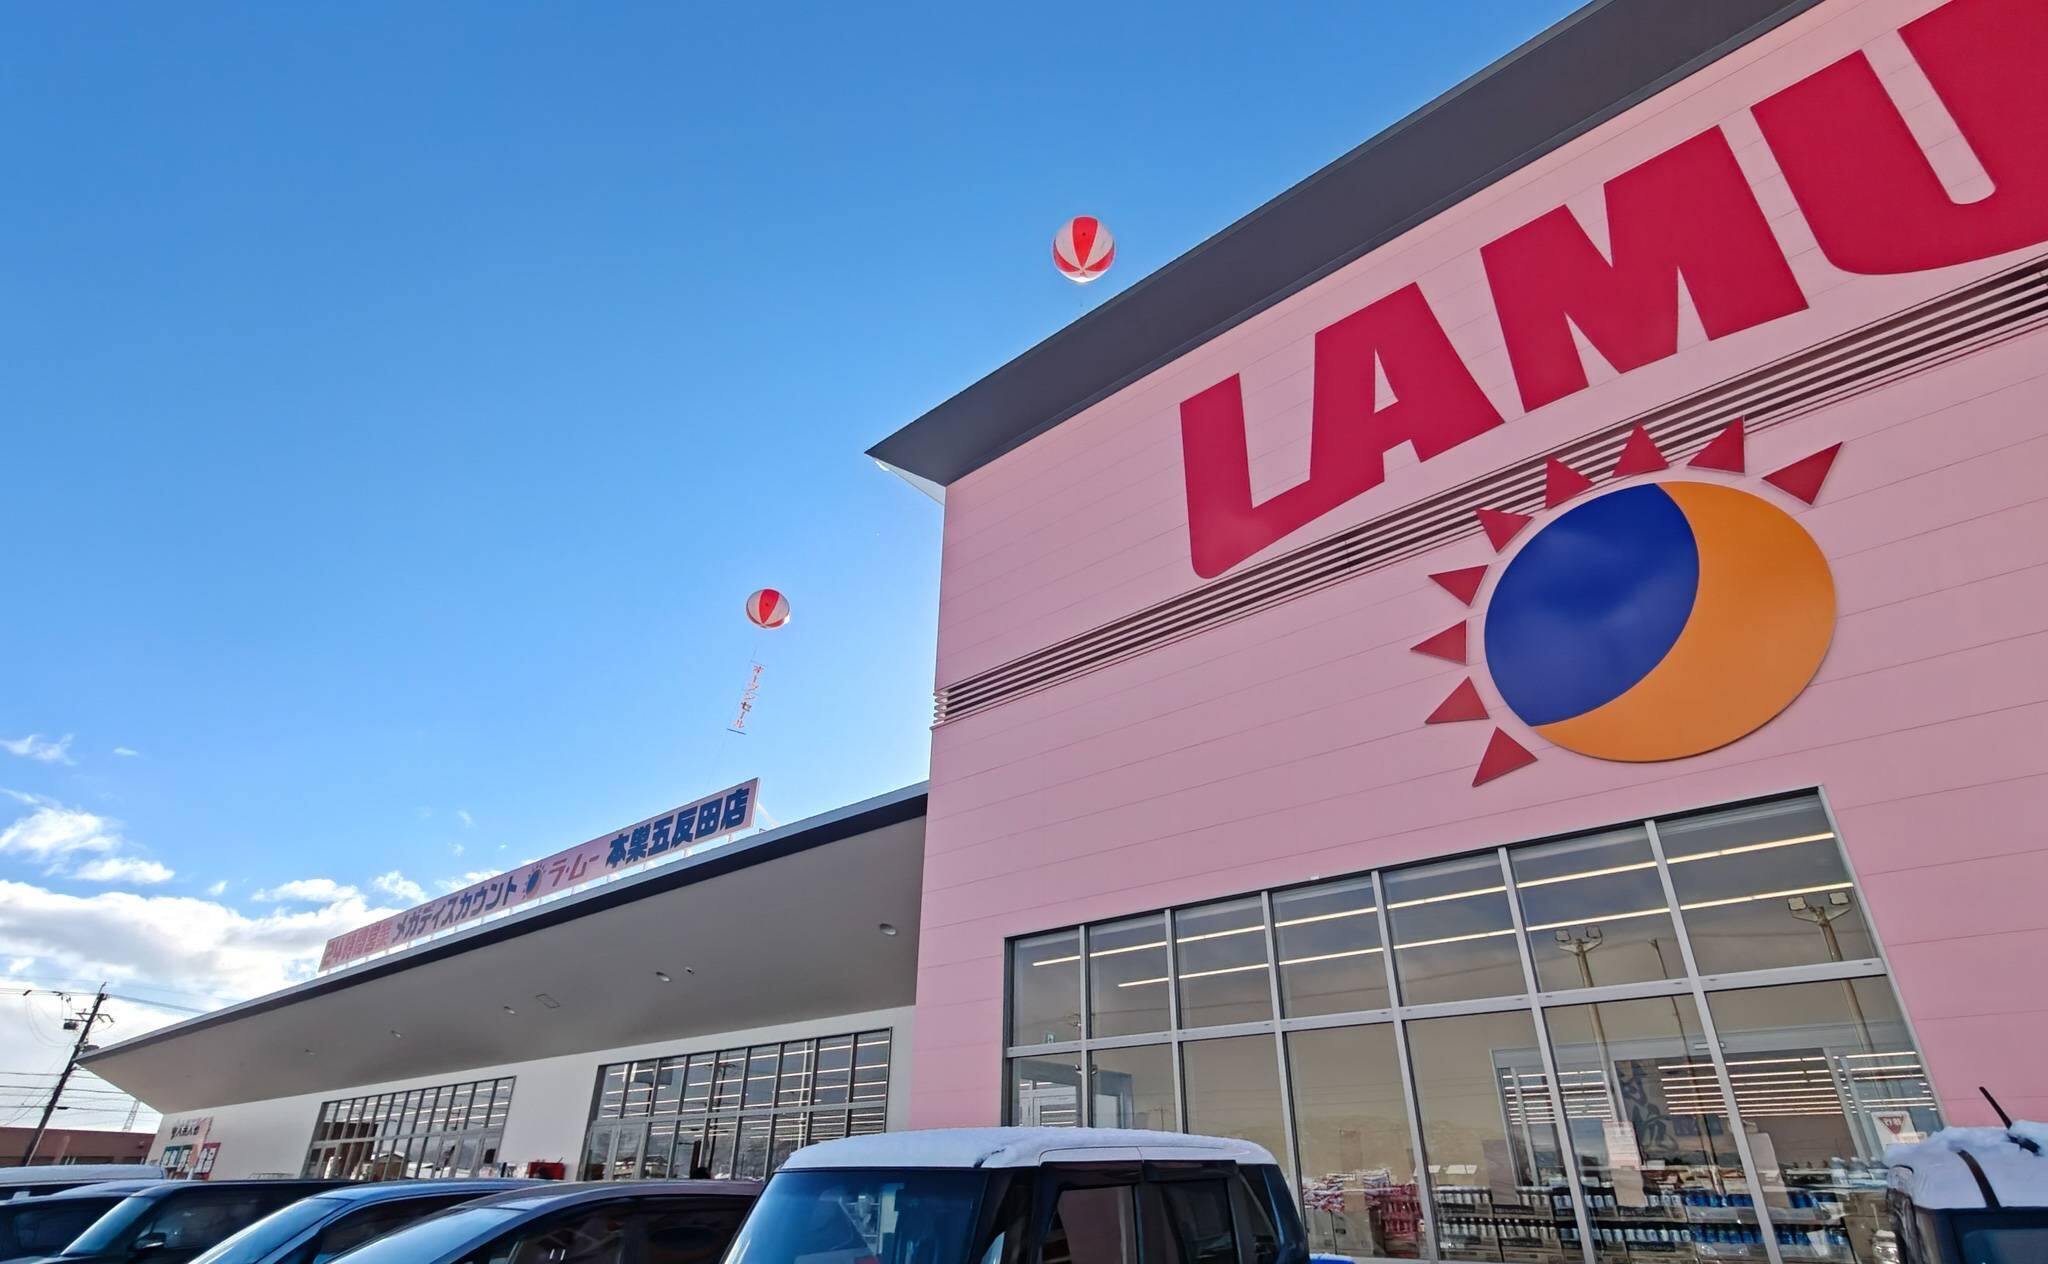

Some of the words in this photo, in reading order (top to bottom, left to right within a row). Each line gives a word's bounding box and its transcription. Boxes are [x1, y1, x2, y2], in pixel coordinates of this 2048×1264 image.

[1180, 0, 2048, 578] LAMU
[392, 876, 518, 943] メガディスカウント
[605, 787, 750, 869] 本巣五反田店
